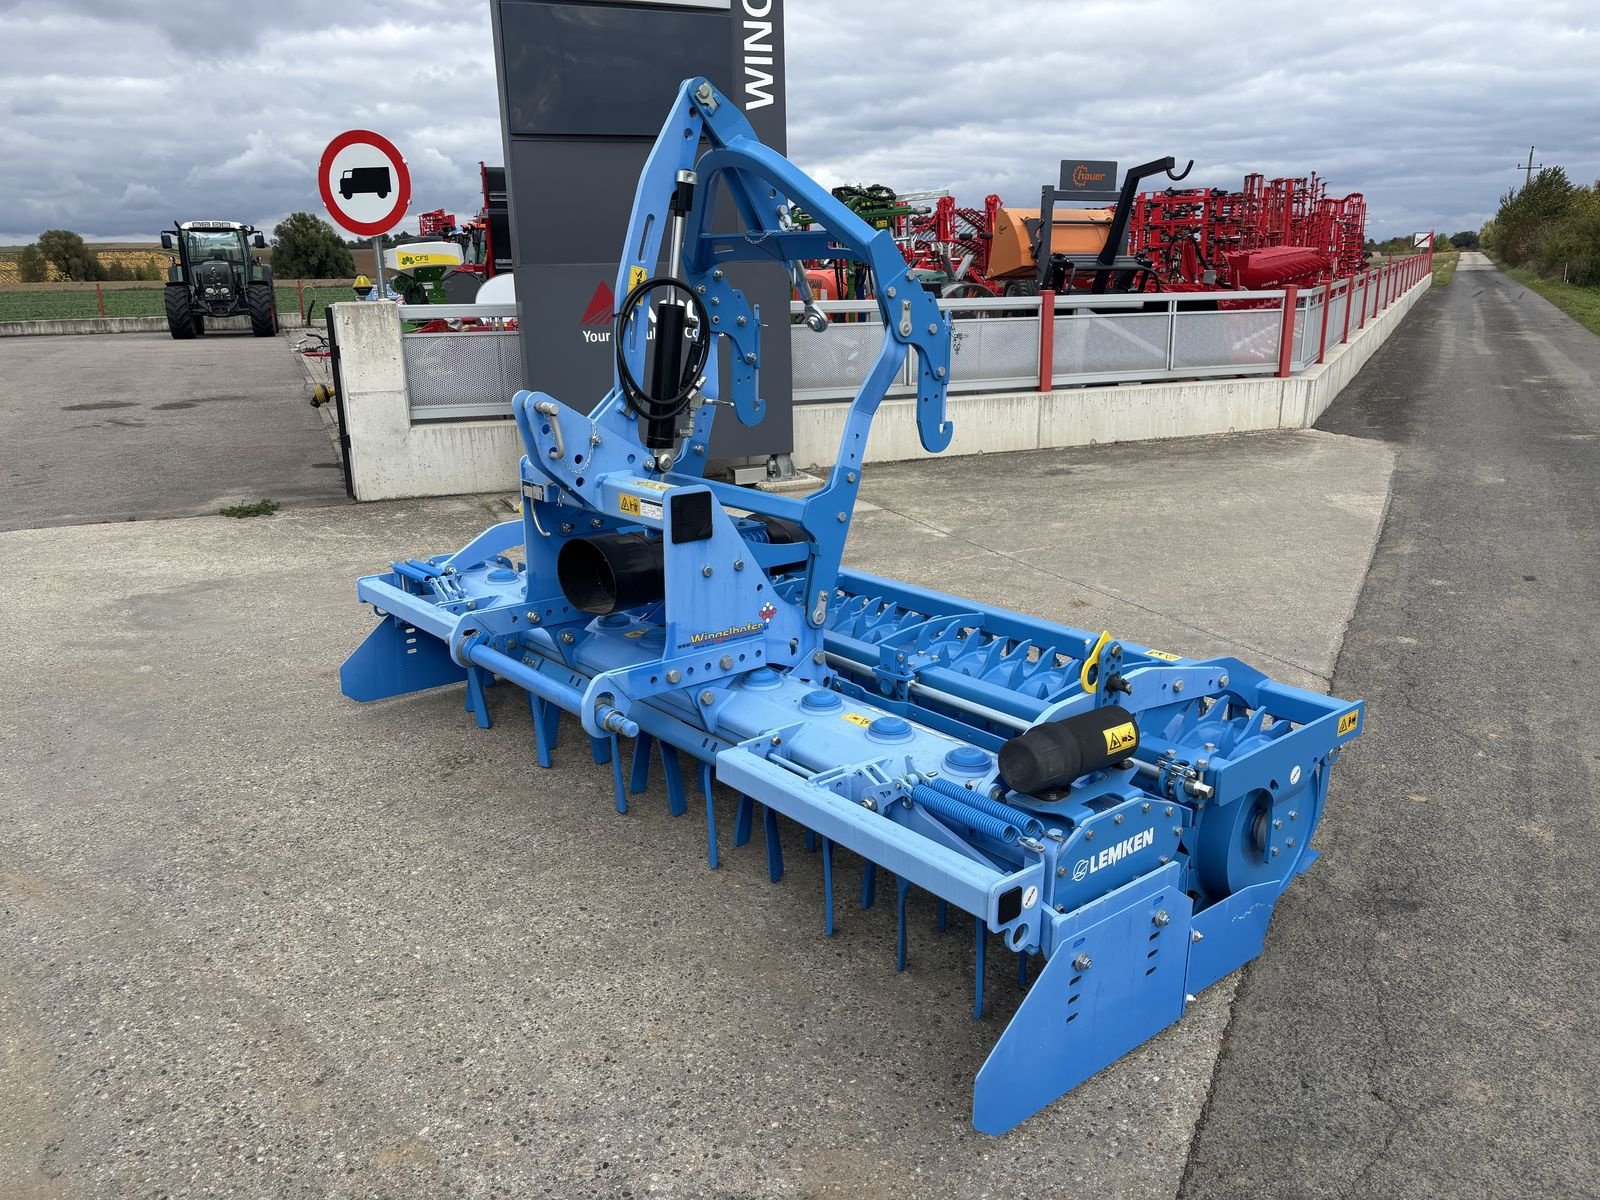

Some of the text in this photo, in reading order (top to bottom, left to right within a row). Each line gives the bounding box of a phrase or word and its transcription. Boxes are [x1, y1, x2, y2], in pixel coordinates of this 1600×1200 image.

[1078, 169, 1106, 181] hauer
[415, 254, 429, 262] CFS
[582, 330, 611, 343] Your
[1089, 827, 1155, 874] LEMKEN
